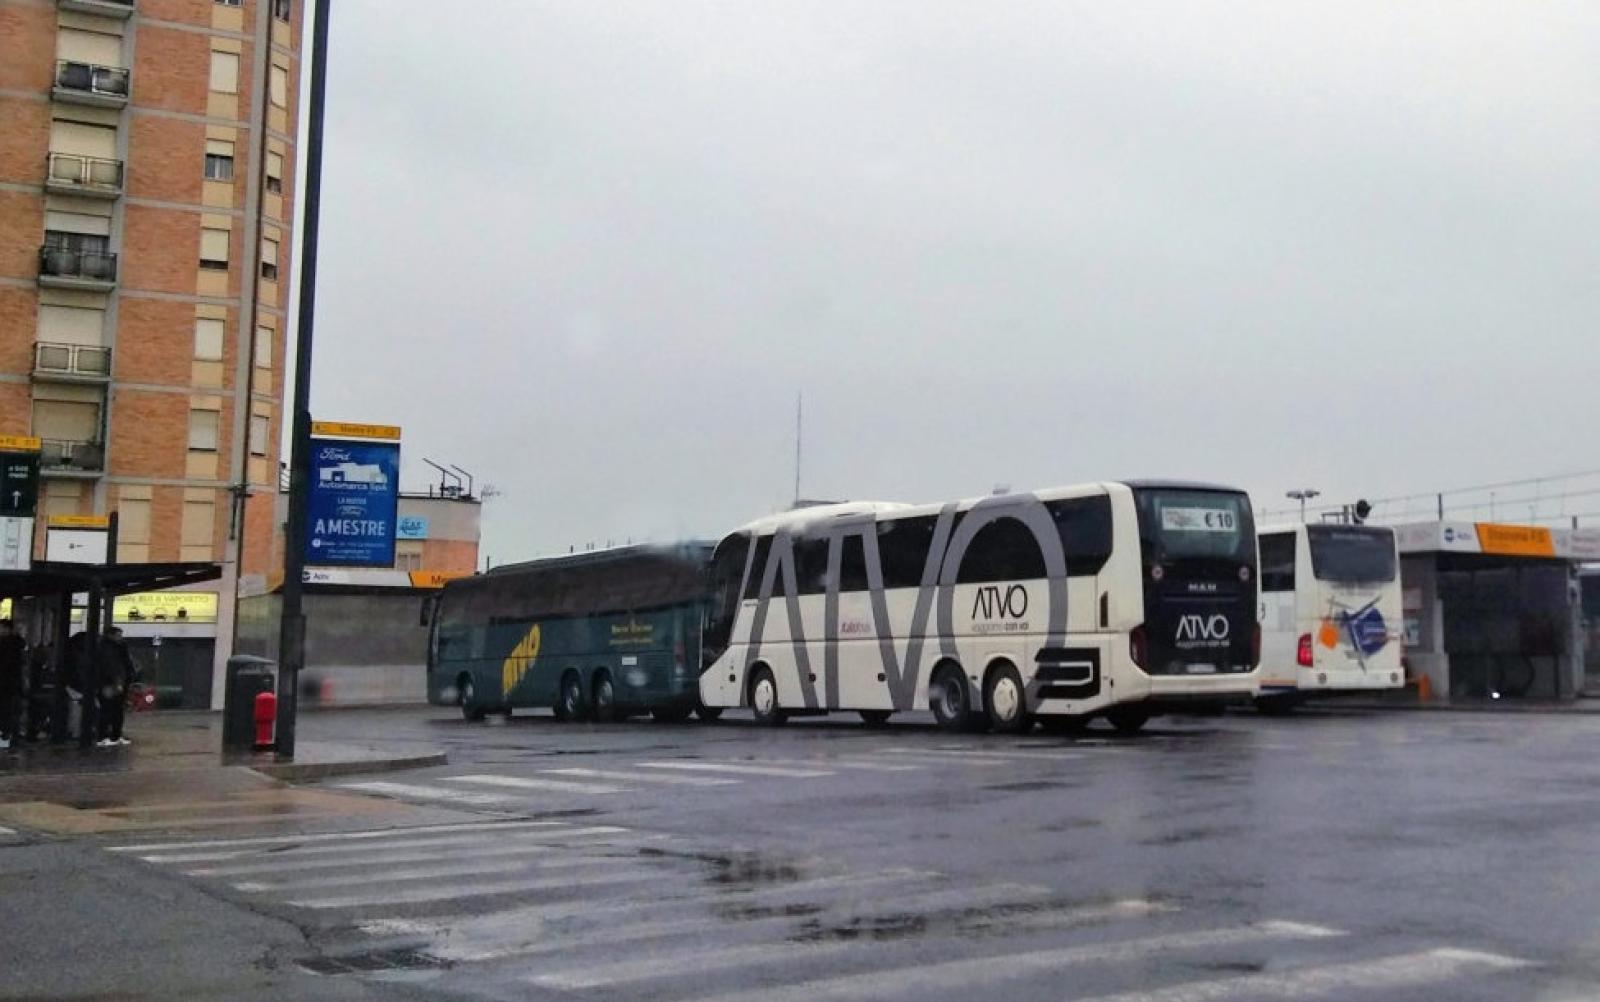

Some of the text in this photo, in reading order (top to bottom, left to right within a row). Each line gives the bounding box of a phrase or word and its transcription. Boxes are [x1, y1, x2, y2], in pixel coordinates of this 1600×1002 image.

[319, 447, 352, 461] Ford
[314, 518, 326, 534] A
[327, 519, 385, 536] MESTRE
[971, 583, 1028, 620] ATVO
[1176, 614, 1229, 639] ATVO
